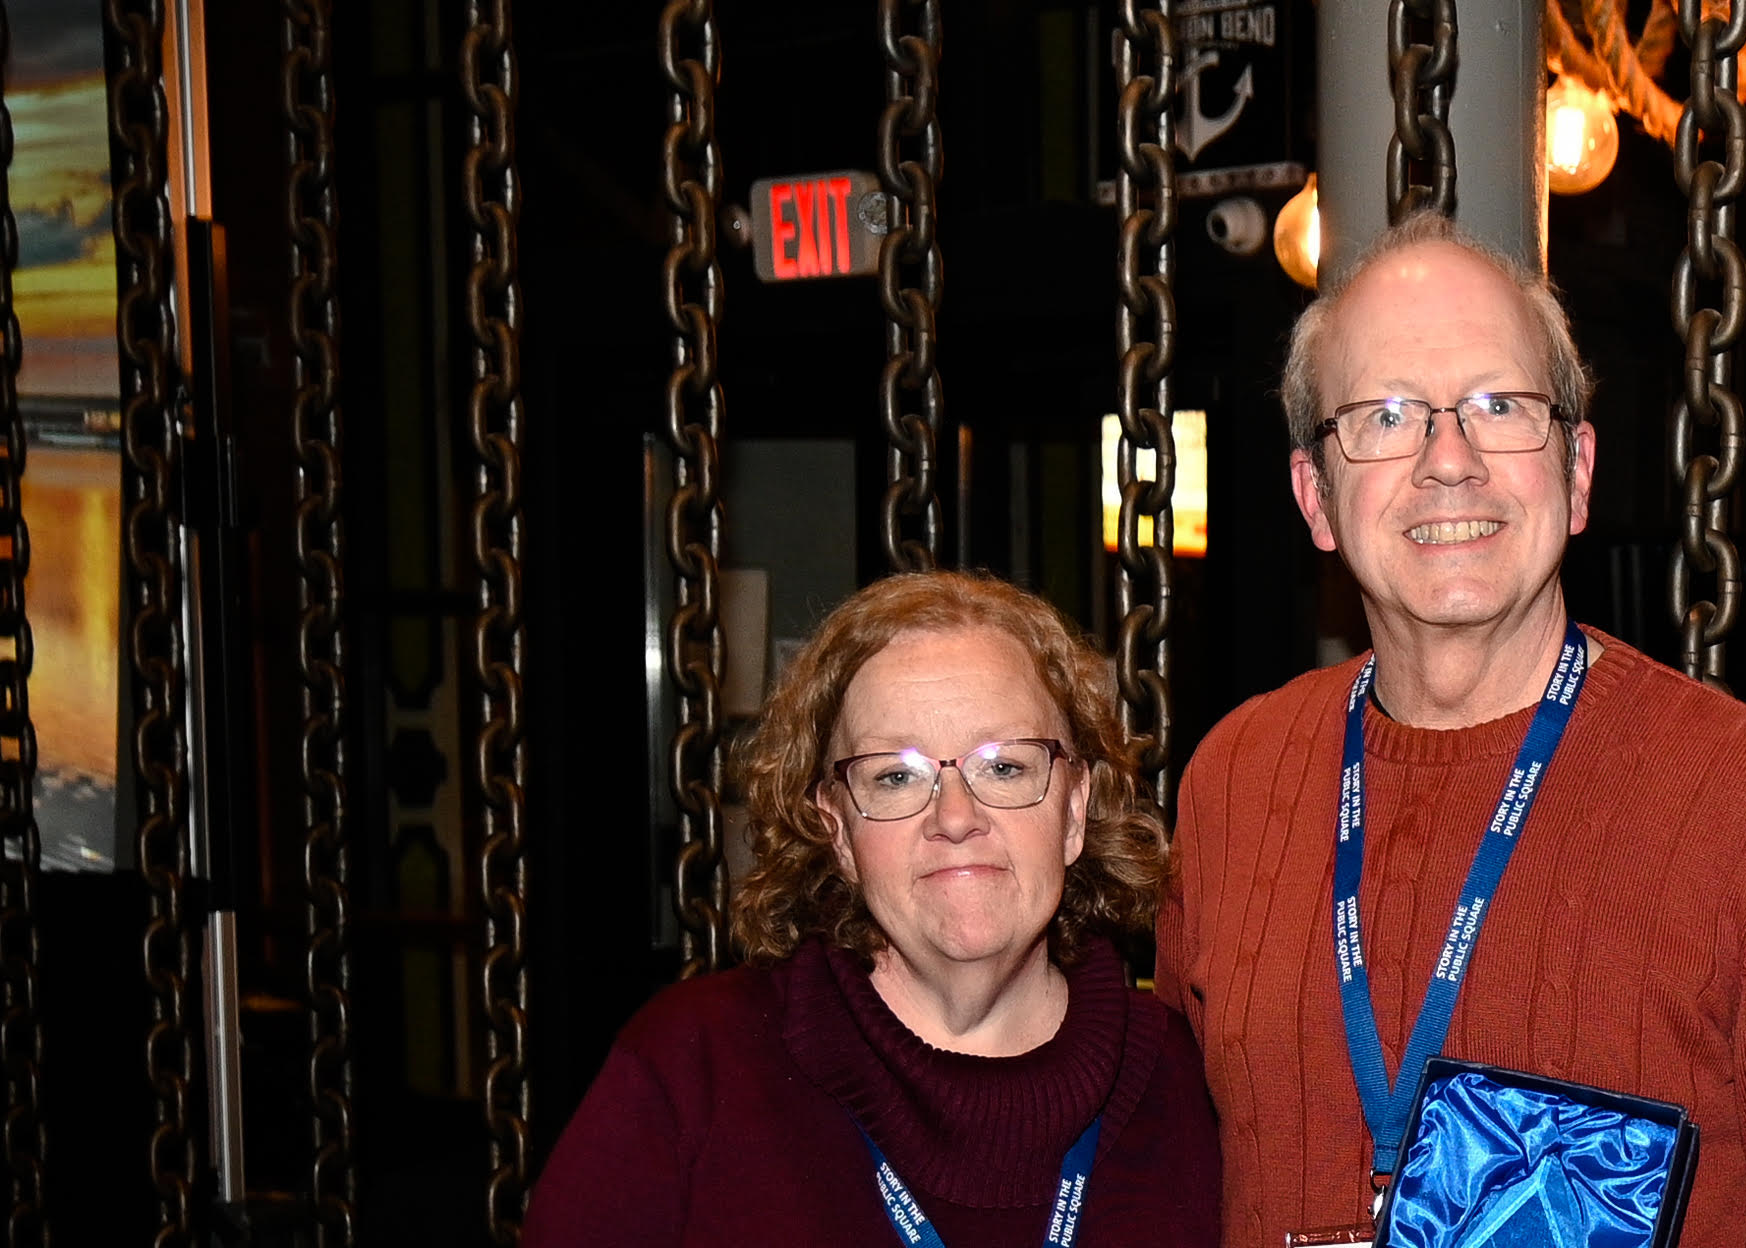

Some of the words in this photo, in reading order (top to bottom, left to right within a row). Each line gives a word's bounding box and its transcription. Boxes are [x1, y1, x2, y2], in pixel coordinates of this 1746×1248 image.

[770, 176, 851, 279] EXIT
[1558, 662, 1569, 674] IN
[1561, 643, 1575, 662] THE
[1547, 673, 1564, 701] STORY
[1559, 673, 1579, 706] PUBLIC
[1342, 767, 1351, 802] PUBLIC
[1352, 762, 1360, 793] STORY
[1509, 768, 1525, 788] THE
[1352, 795, 1361, 807] IN
[1503, 801, 1525, 836] PUBLIC
[1518, 760, 1542, 800] SQUARE
[1504, 789, 1516, 801] IN
[1339, 803, 1350, 843] SQUARE
[1352, 808, 1361, 829] THE
[1490, 801, 1510, 833] STORY
[1337, 901, 1346, 938] PUBLIC
[1347, 896, 1358, 929] STORY
[1454, 905, 1468, 928] THE
[1350, 930, 1359, 944] IN
[1448, 943, 1469, 982] PUBLIC
[1462, 897, 1485, 941] SQUARE
[1450, 929, 1460, 943] IN
[1338, 938, 1352, 983] SQUARE
[1352, 943, 1363, 967] THE
[1436, 943, 1454, 979] STORY
[880, 1161, 902, 1192] STORY
[899, 1190, 912, 1206] IN
[909, 1202, 926, 1226] THE
[1059, 1178, 1073, 1198] THE
[876, 1171, 896, 1206] PUBLIC
[891, 1204, 921, 1244] SQUARE
[1057, 1198, 1067, 1211] IN
[1060, 1212, 1076, 1248] PUBLIC
[1069, 1173, 1086, 1214] SQUARE
[1048, 1210, 1063, 1244] STORY
